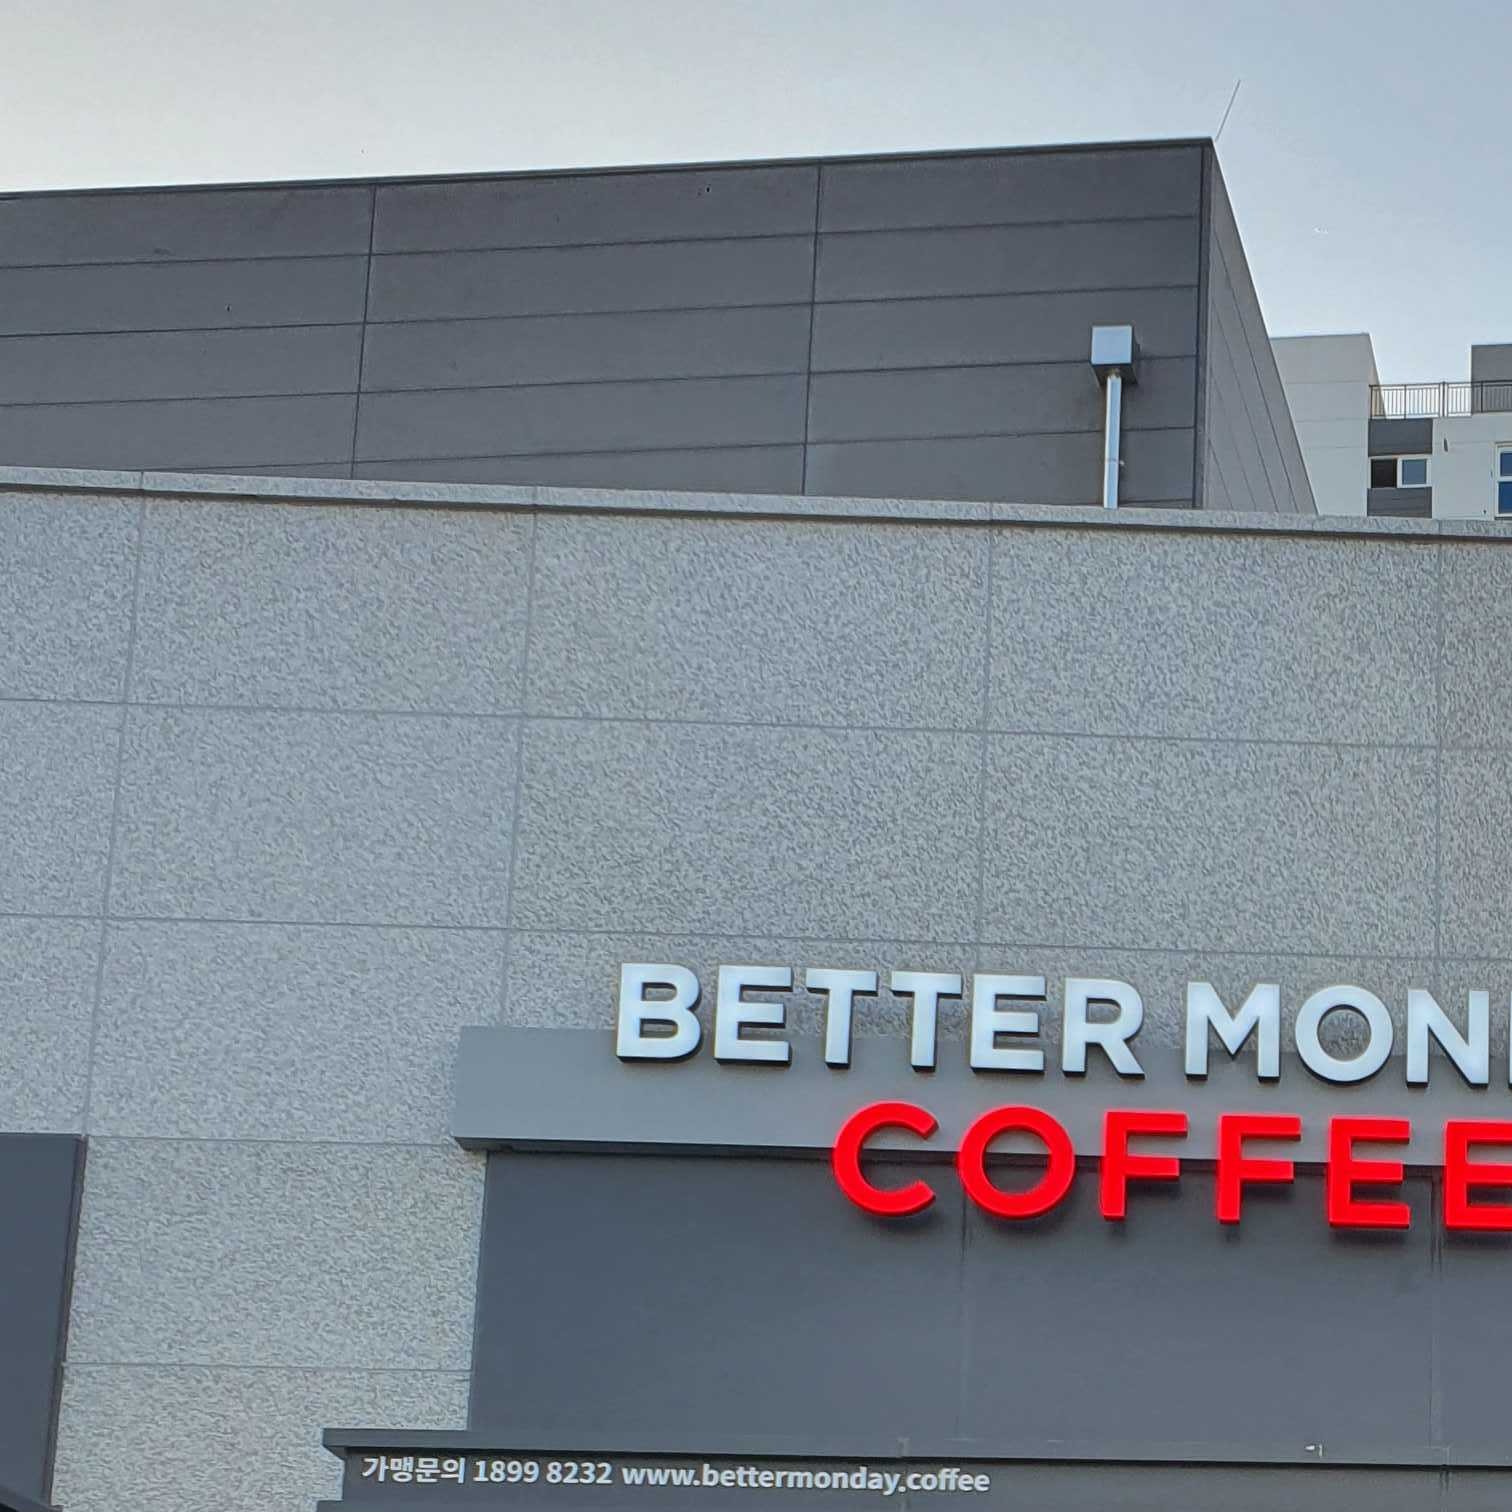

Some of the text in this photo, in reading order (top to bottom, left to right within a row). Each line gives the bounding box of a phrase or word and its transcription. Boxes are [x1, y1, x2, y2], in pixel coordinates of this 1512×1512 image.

[615, 962, 1146, 1079] BETTER
[362, 1456, 991, 1494] 가맹문의 1899 8232 www.bettermonday.coffee
